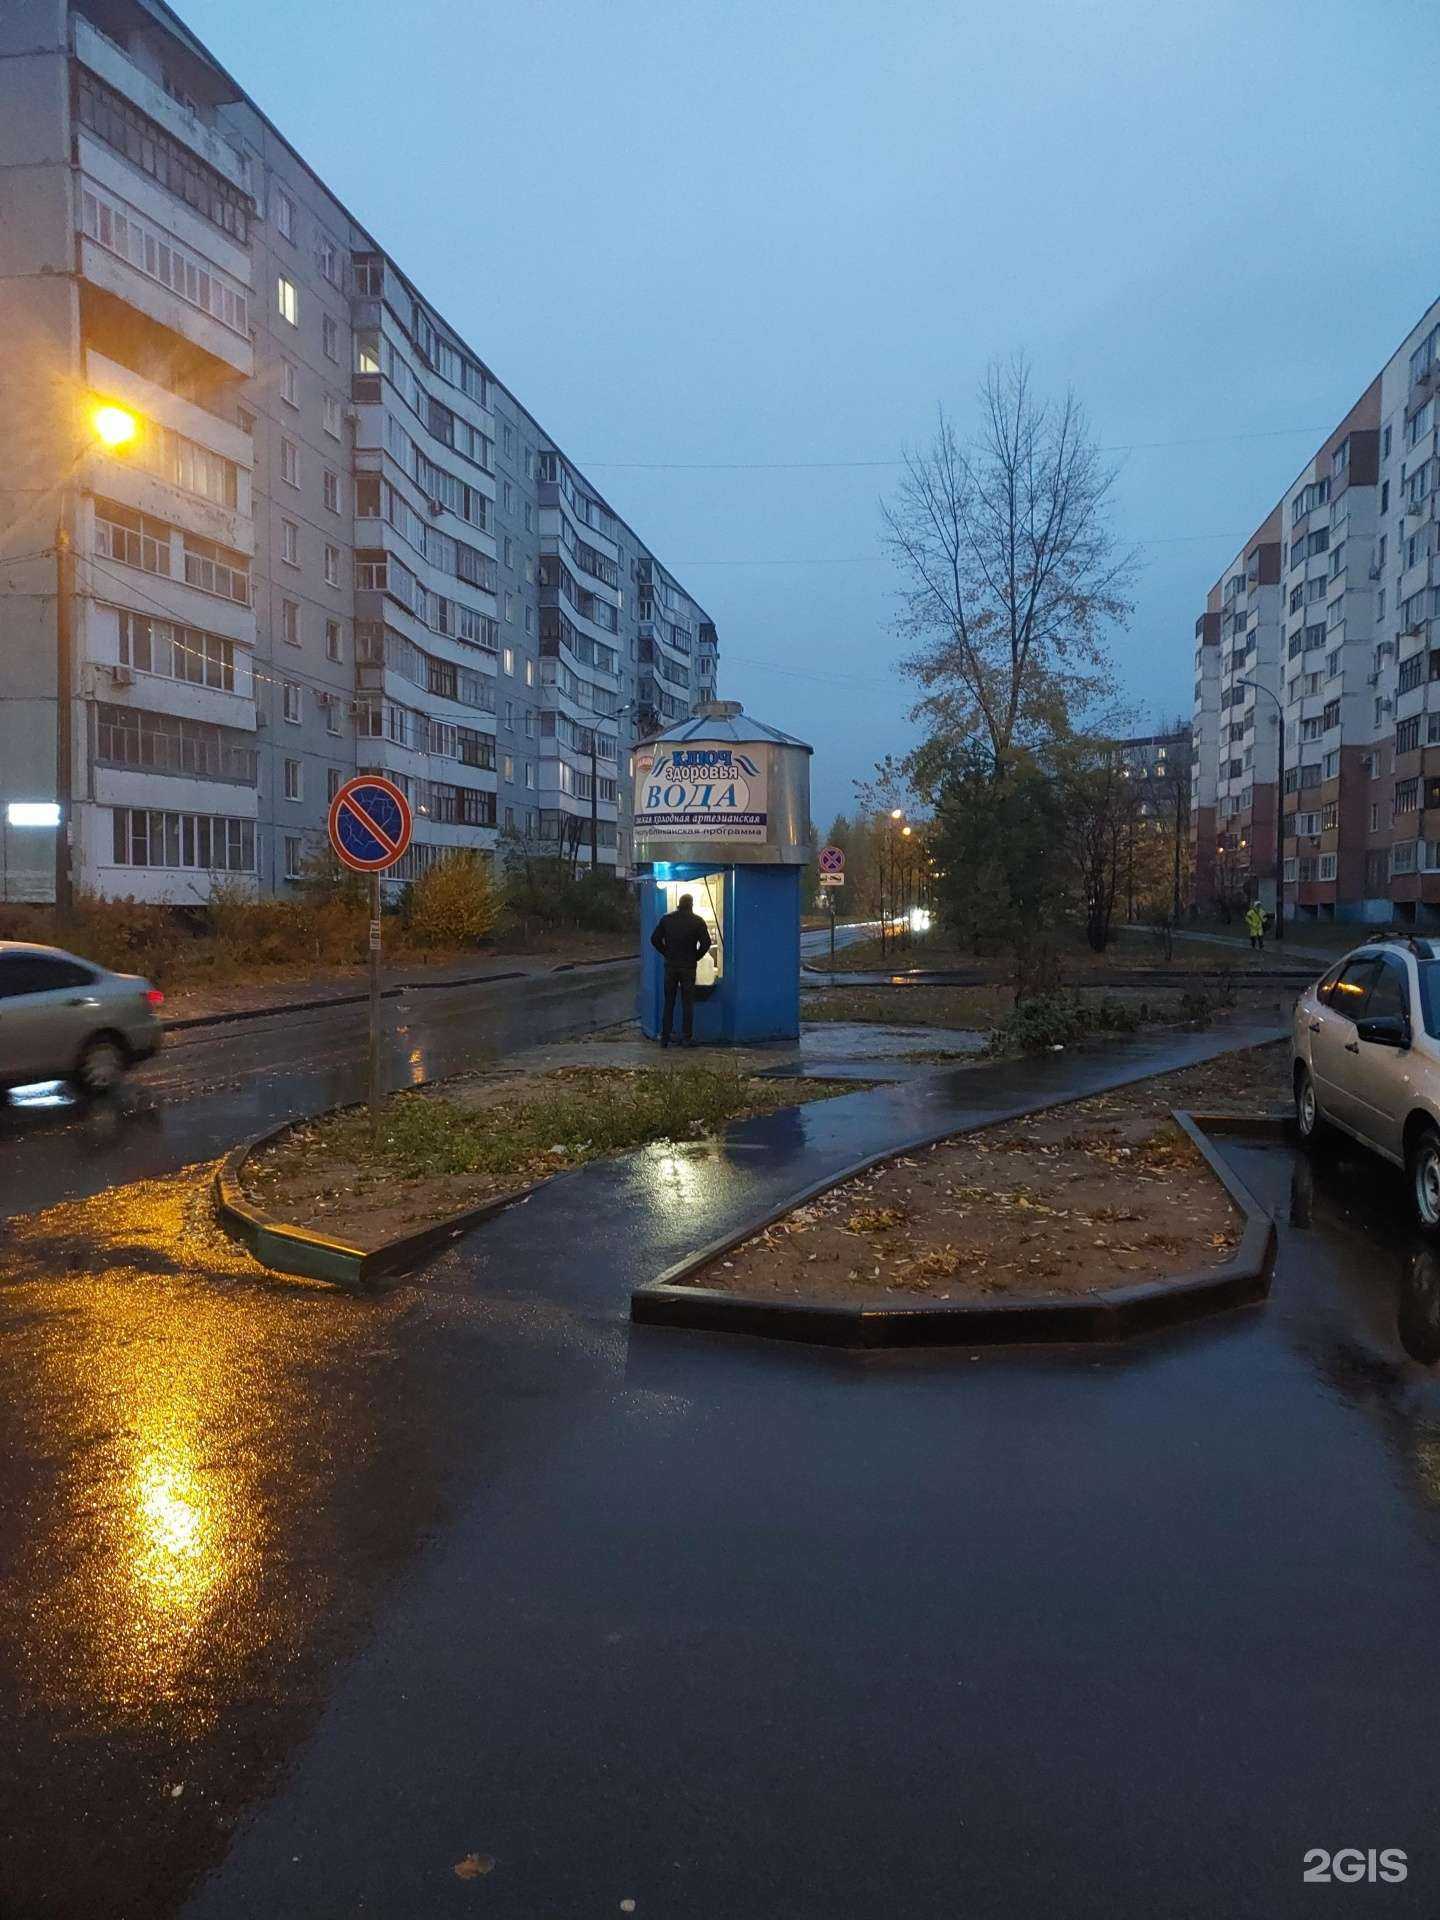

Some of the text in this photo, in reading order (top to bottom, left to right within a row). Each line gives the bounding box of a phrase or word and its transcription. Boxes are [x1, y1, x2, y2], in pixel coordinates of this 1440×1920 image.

[671, 750, 733, 767] КЛЮЧ
[646, 783, 738, 812] ВОДА
[692, 814, 760, 824] артезианская
[703, 828, 762, 837] программа
